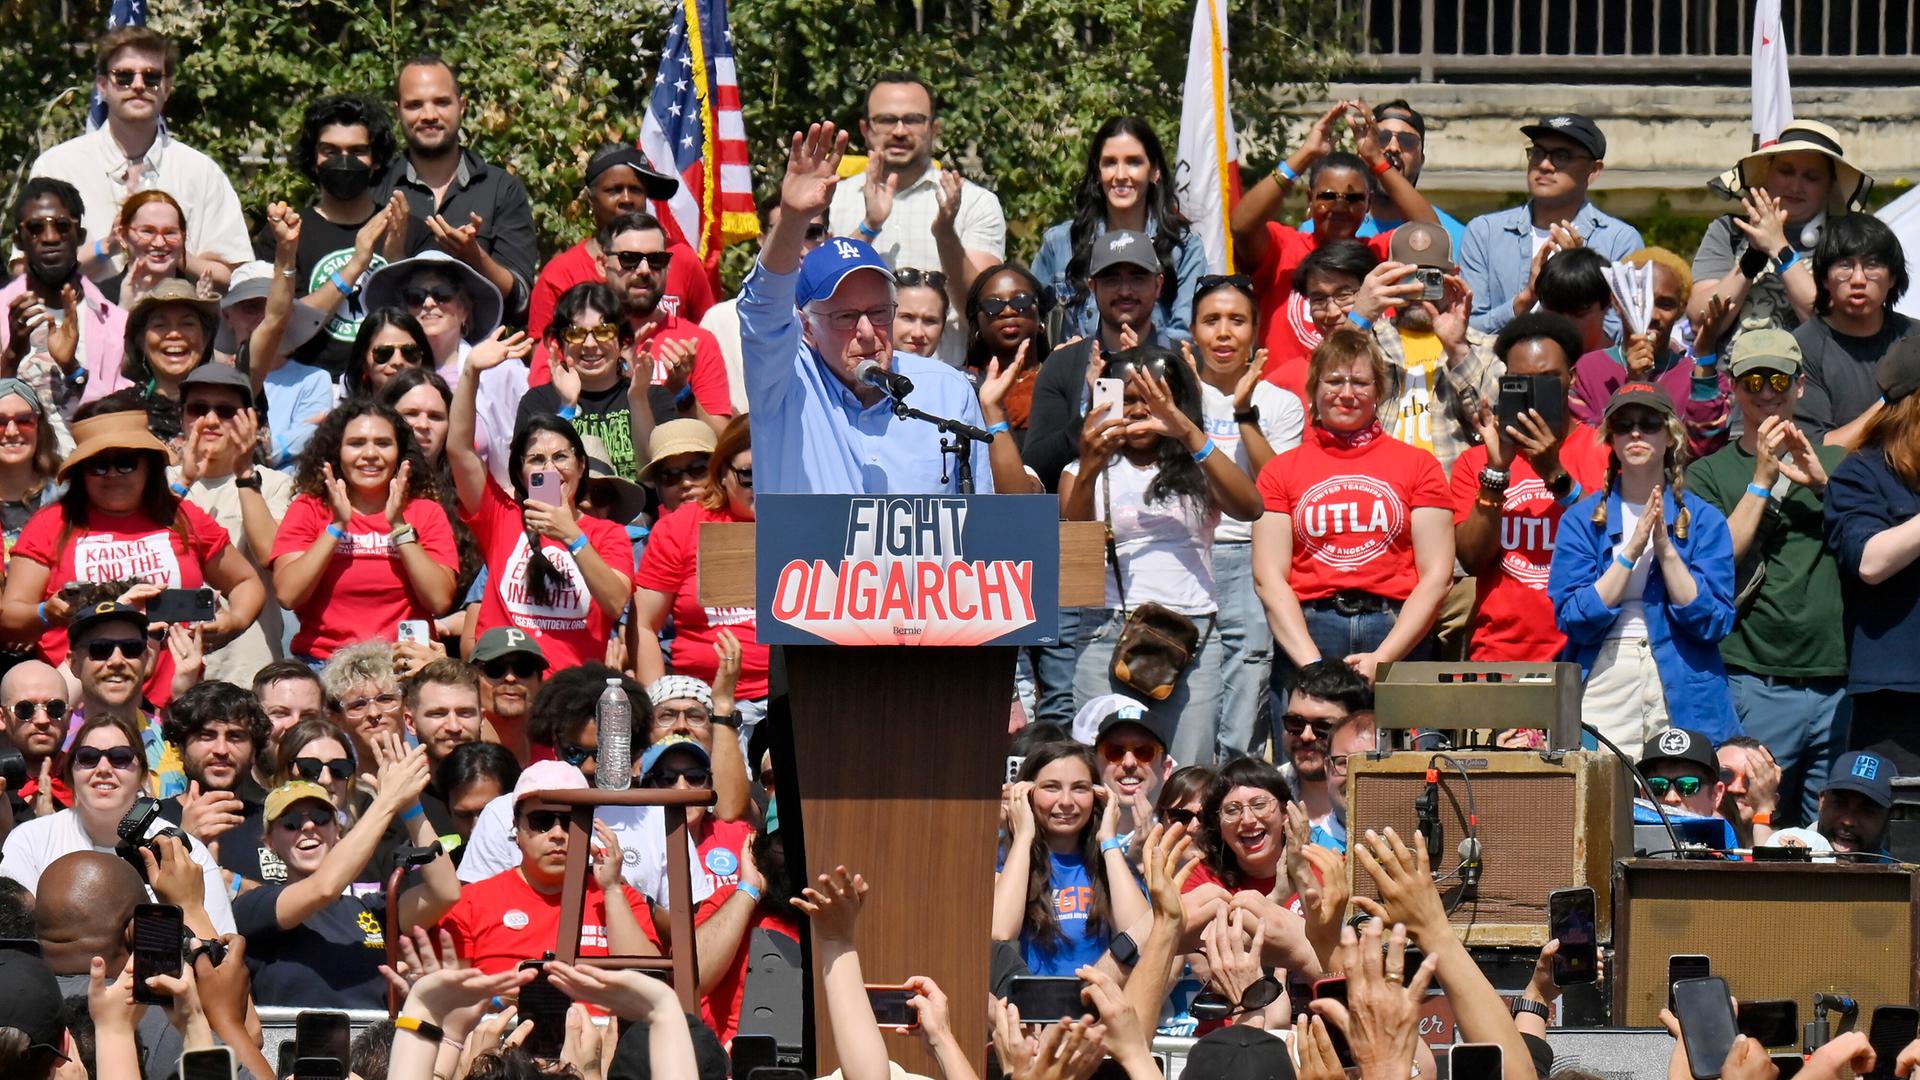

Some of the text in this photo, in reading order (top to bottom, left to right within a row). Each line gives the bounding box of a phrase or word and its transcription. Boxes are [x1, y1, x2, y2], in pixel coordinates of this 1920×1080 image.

[833, 239, 861, 259] LA
[1311, 484, 1383, 503] UNITED TEACHERS
[845, 498, 968, 558] FIGHT
[1305, 500, 1389, 537] UTLA
[1501, 516, 1556, 551] UTL
[1323, 539, 1376, 555] LOS ANGELES
[772, 559, 1036, 622] OLIGARCHY
[96, 601, 115, 614] C
[506, 628, 526, 647] P
[893, 625, 922, 636] Bernie
[1418, 1014, 1446, 1035] er
